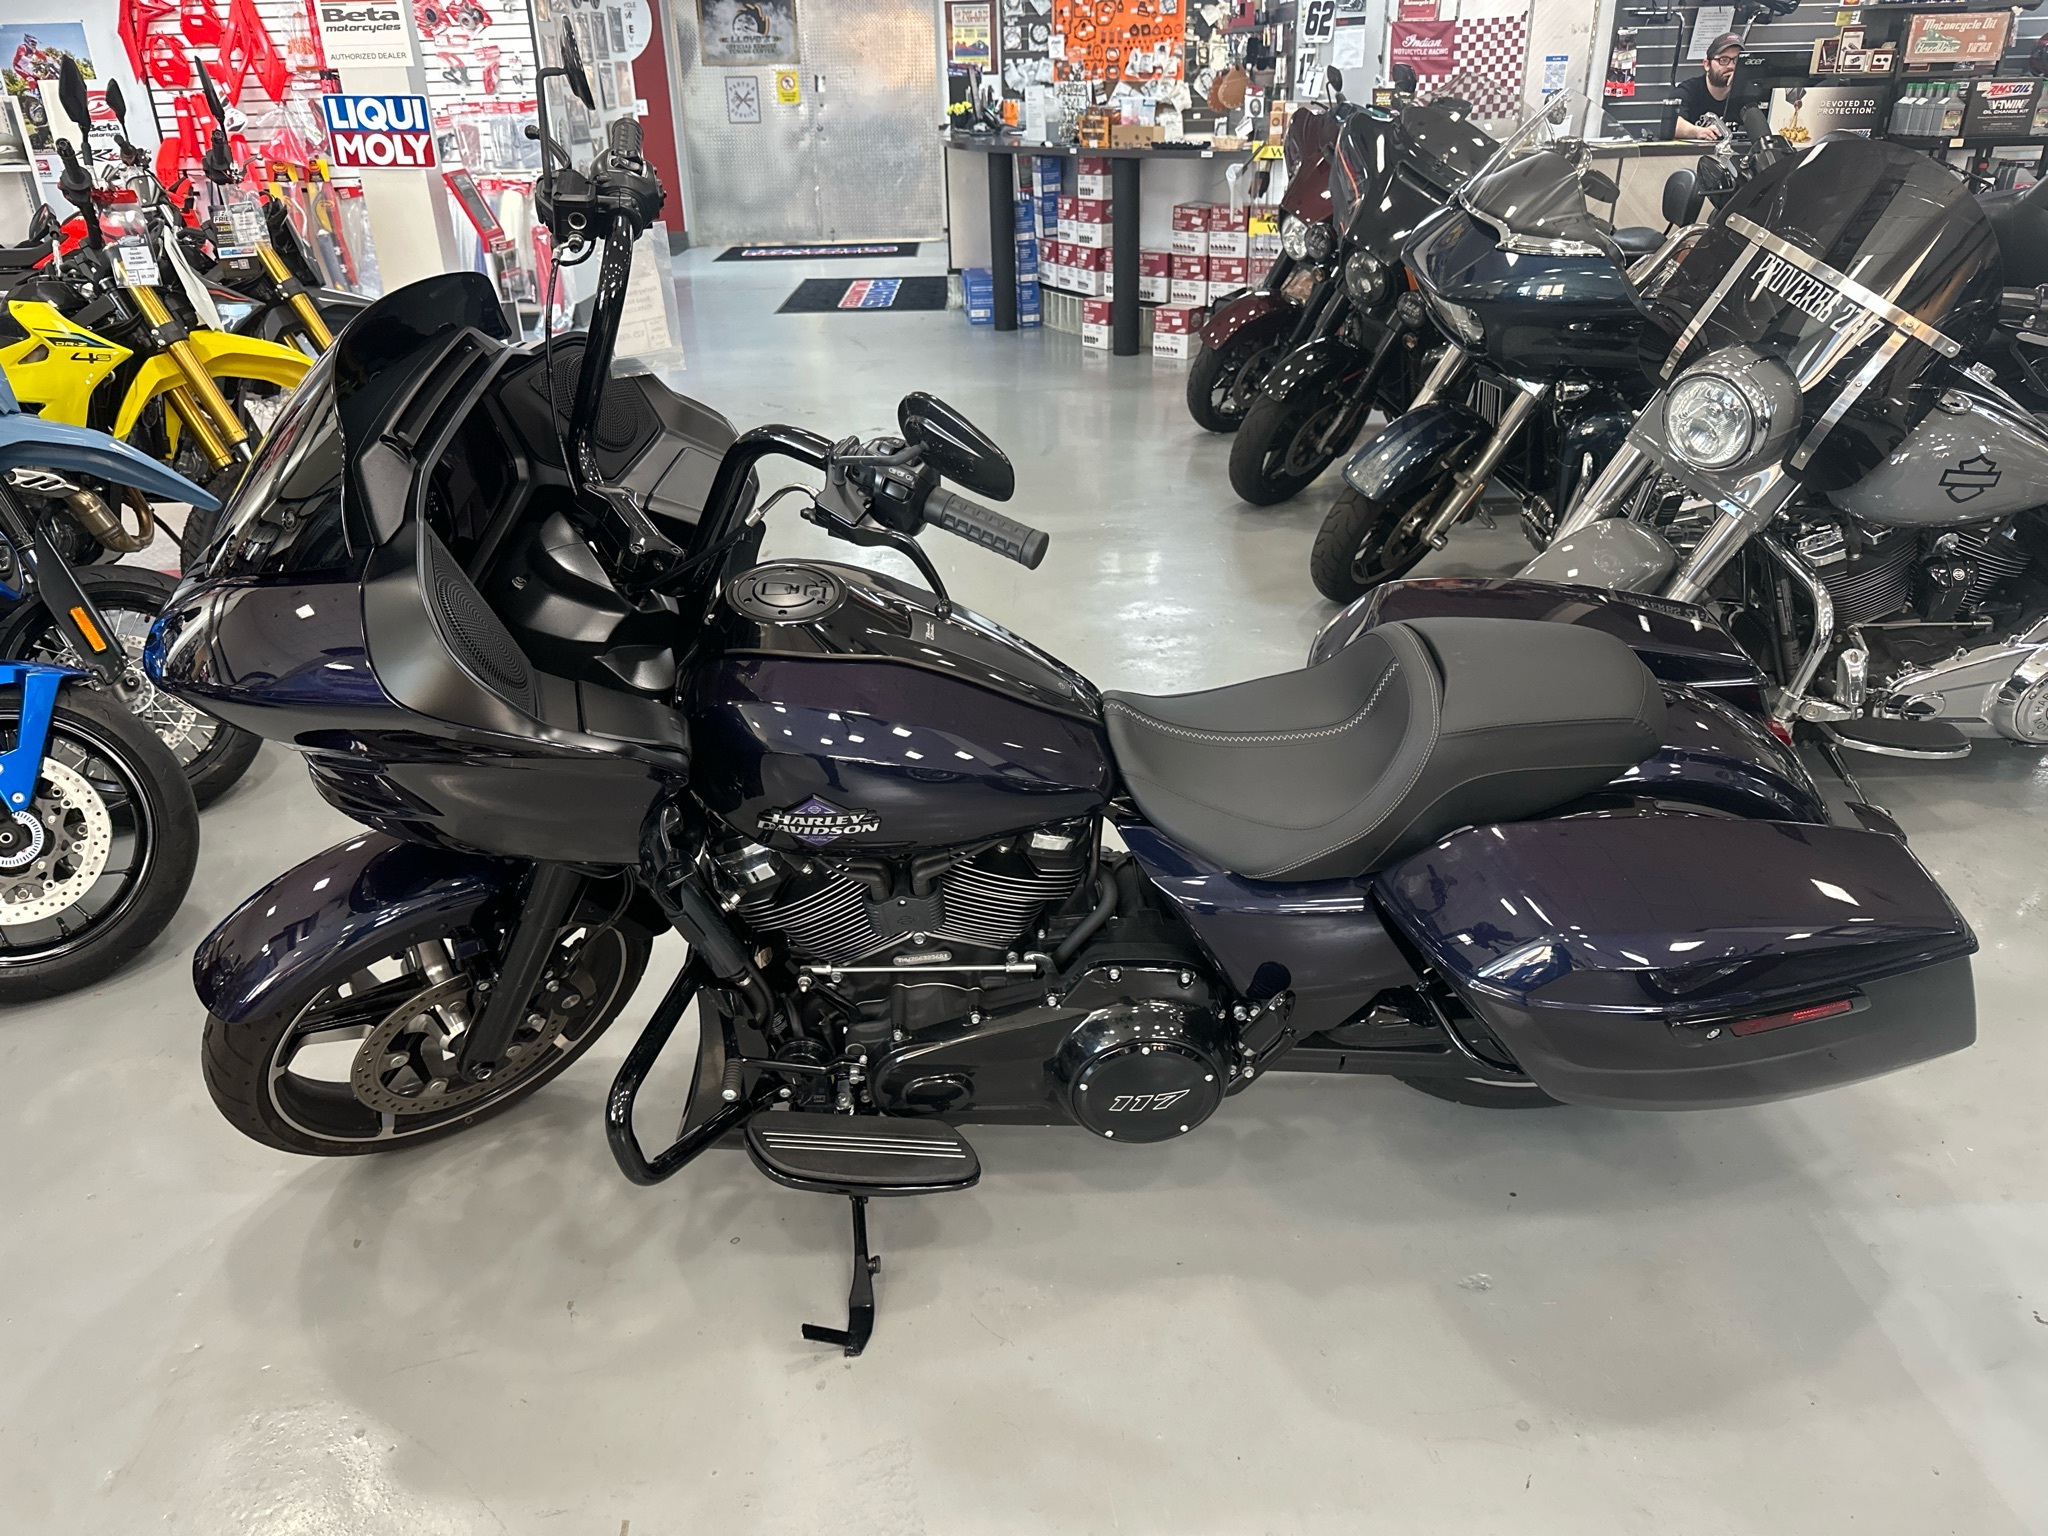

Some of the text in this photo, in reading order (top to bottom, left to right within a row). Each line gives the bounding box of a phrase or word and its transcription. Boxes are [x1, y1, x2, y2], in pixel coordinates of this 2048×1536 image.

[322, 8, 400, 22] Beta
[1305, 1, 1335, 35] 62
[326, 23, 401, 33] motorcycles
[1923, 18, 1998, 32] Motorcycle Oil
[1402, 34, 1442, 47] Indian
[1987, 84, 2030, 96] AMSOIL
[1992, 100, 2024, 109] V-TWIN
[328, 97, 425, 131] LIQUI
[334, 134, 430, 165] MOLY
[1751, 252, 1843, 323] PROVERBS
[772, 814, 866, 825] HARLEY
[758, 820, 879, 835] DAVIDSON
[1108, 1089, 1190, 1112] 117
